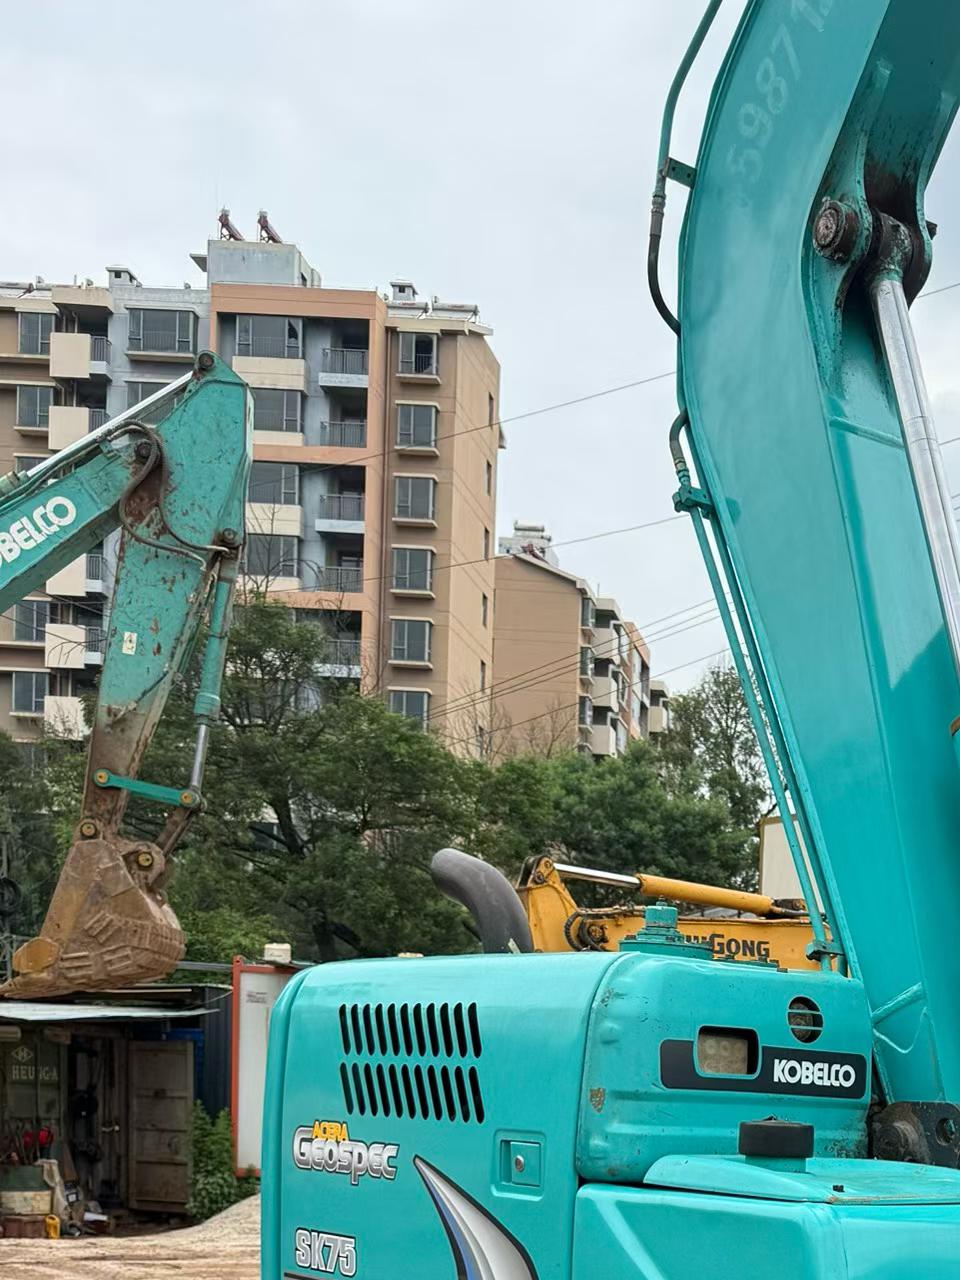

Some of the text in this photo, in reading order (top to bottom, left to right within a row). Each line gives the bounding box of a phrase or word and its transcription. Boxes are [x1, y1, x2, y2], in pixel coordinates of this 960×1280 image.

[0, 496, 77, 569] BELCO
[685, 933, 770, 958] GONG
[773, 1058, 856, 1088] KOBELCO
[295, 1228, 357, 1277] SK75
